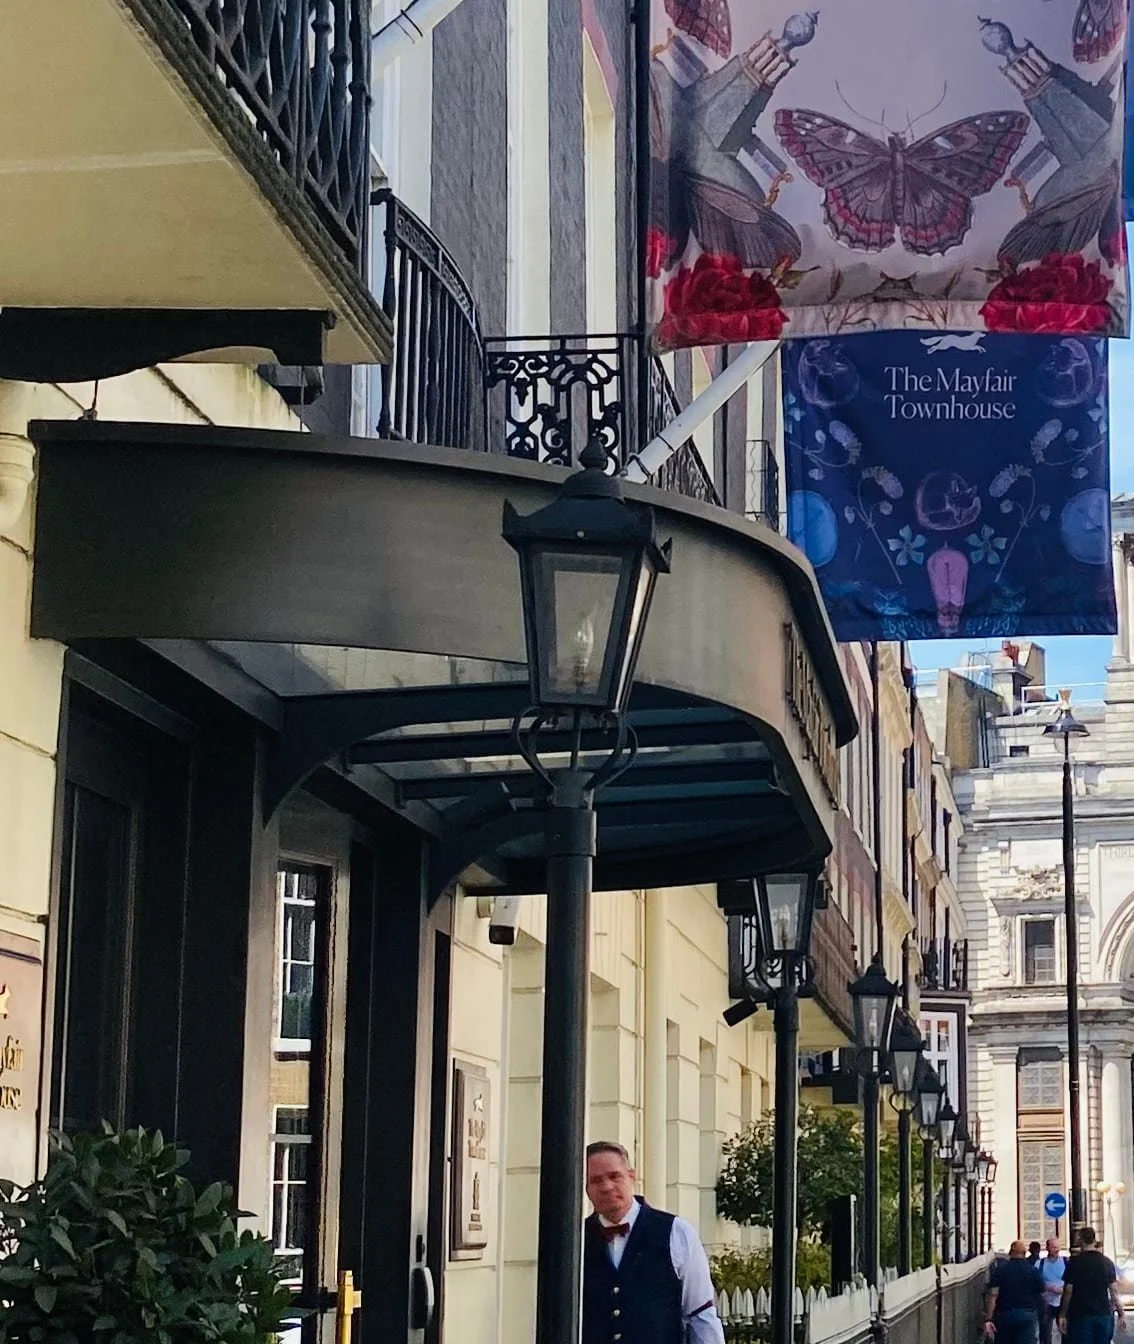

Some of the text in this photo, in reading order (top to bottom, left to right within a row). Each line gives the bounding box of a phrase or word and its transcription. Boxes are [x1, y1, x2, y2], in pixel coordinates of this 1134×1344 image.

[884, 366, 1018, 399] The Mayfair
[883, 394, 1017, 420] Townhouse
